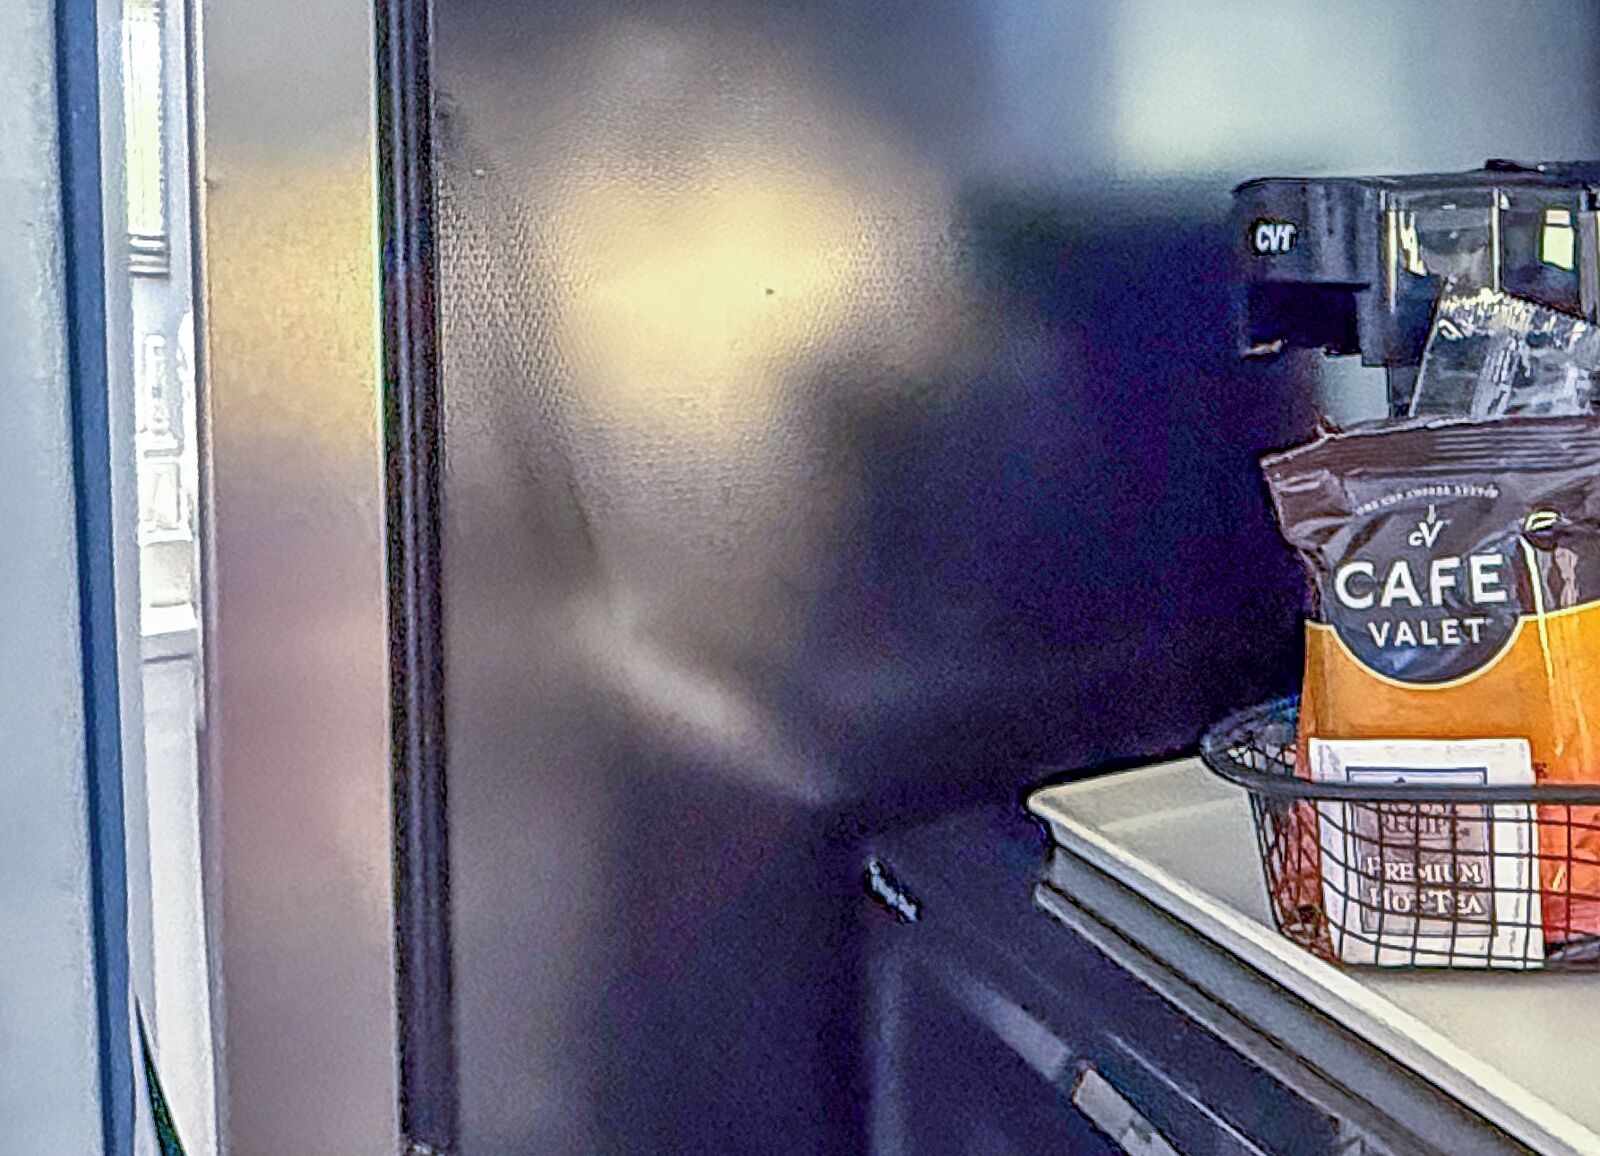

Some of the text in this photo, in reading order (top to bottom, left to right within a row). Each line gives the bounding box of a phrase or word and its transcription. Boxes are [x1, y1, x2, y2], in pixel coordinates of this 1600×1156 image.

[1367, 617, 1485, 649] VALET
[1367, 856, 1484, 883] PREMIUM
[1369, 886, 1427, 913] HO
